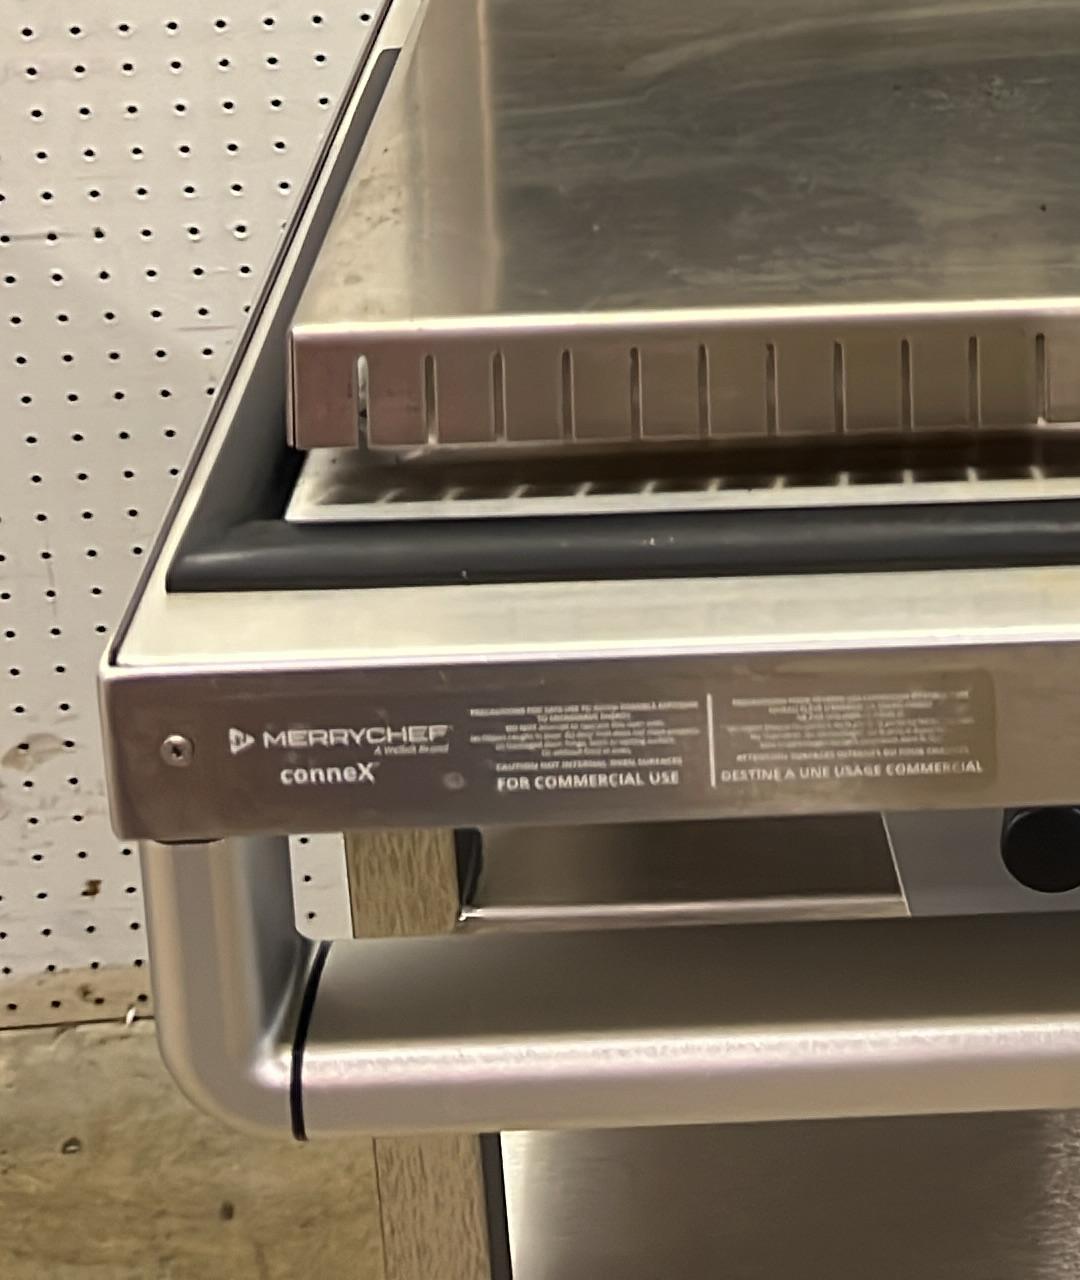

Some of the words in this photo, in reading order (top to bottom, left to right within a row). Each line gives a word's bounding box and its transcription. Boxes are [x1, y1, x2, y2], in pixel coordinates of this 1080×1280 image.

[262, 725, 449, 748] MERRYCHEF
[280, 762, 375, 784] conneX
[800, 764, 830, 779] UNE
[834, 762, 881, 778] USAGE
[885, 759, 984, 777] COMMERCIAL
[497, 776, 531, 792] FOR
[534, 771, 645, 790] COMMERCIAL
[649, 770, 680, 786] USE
